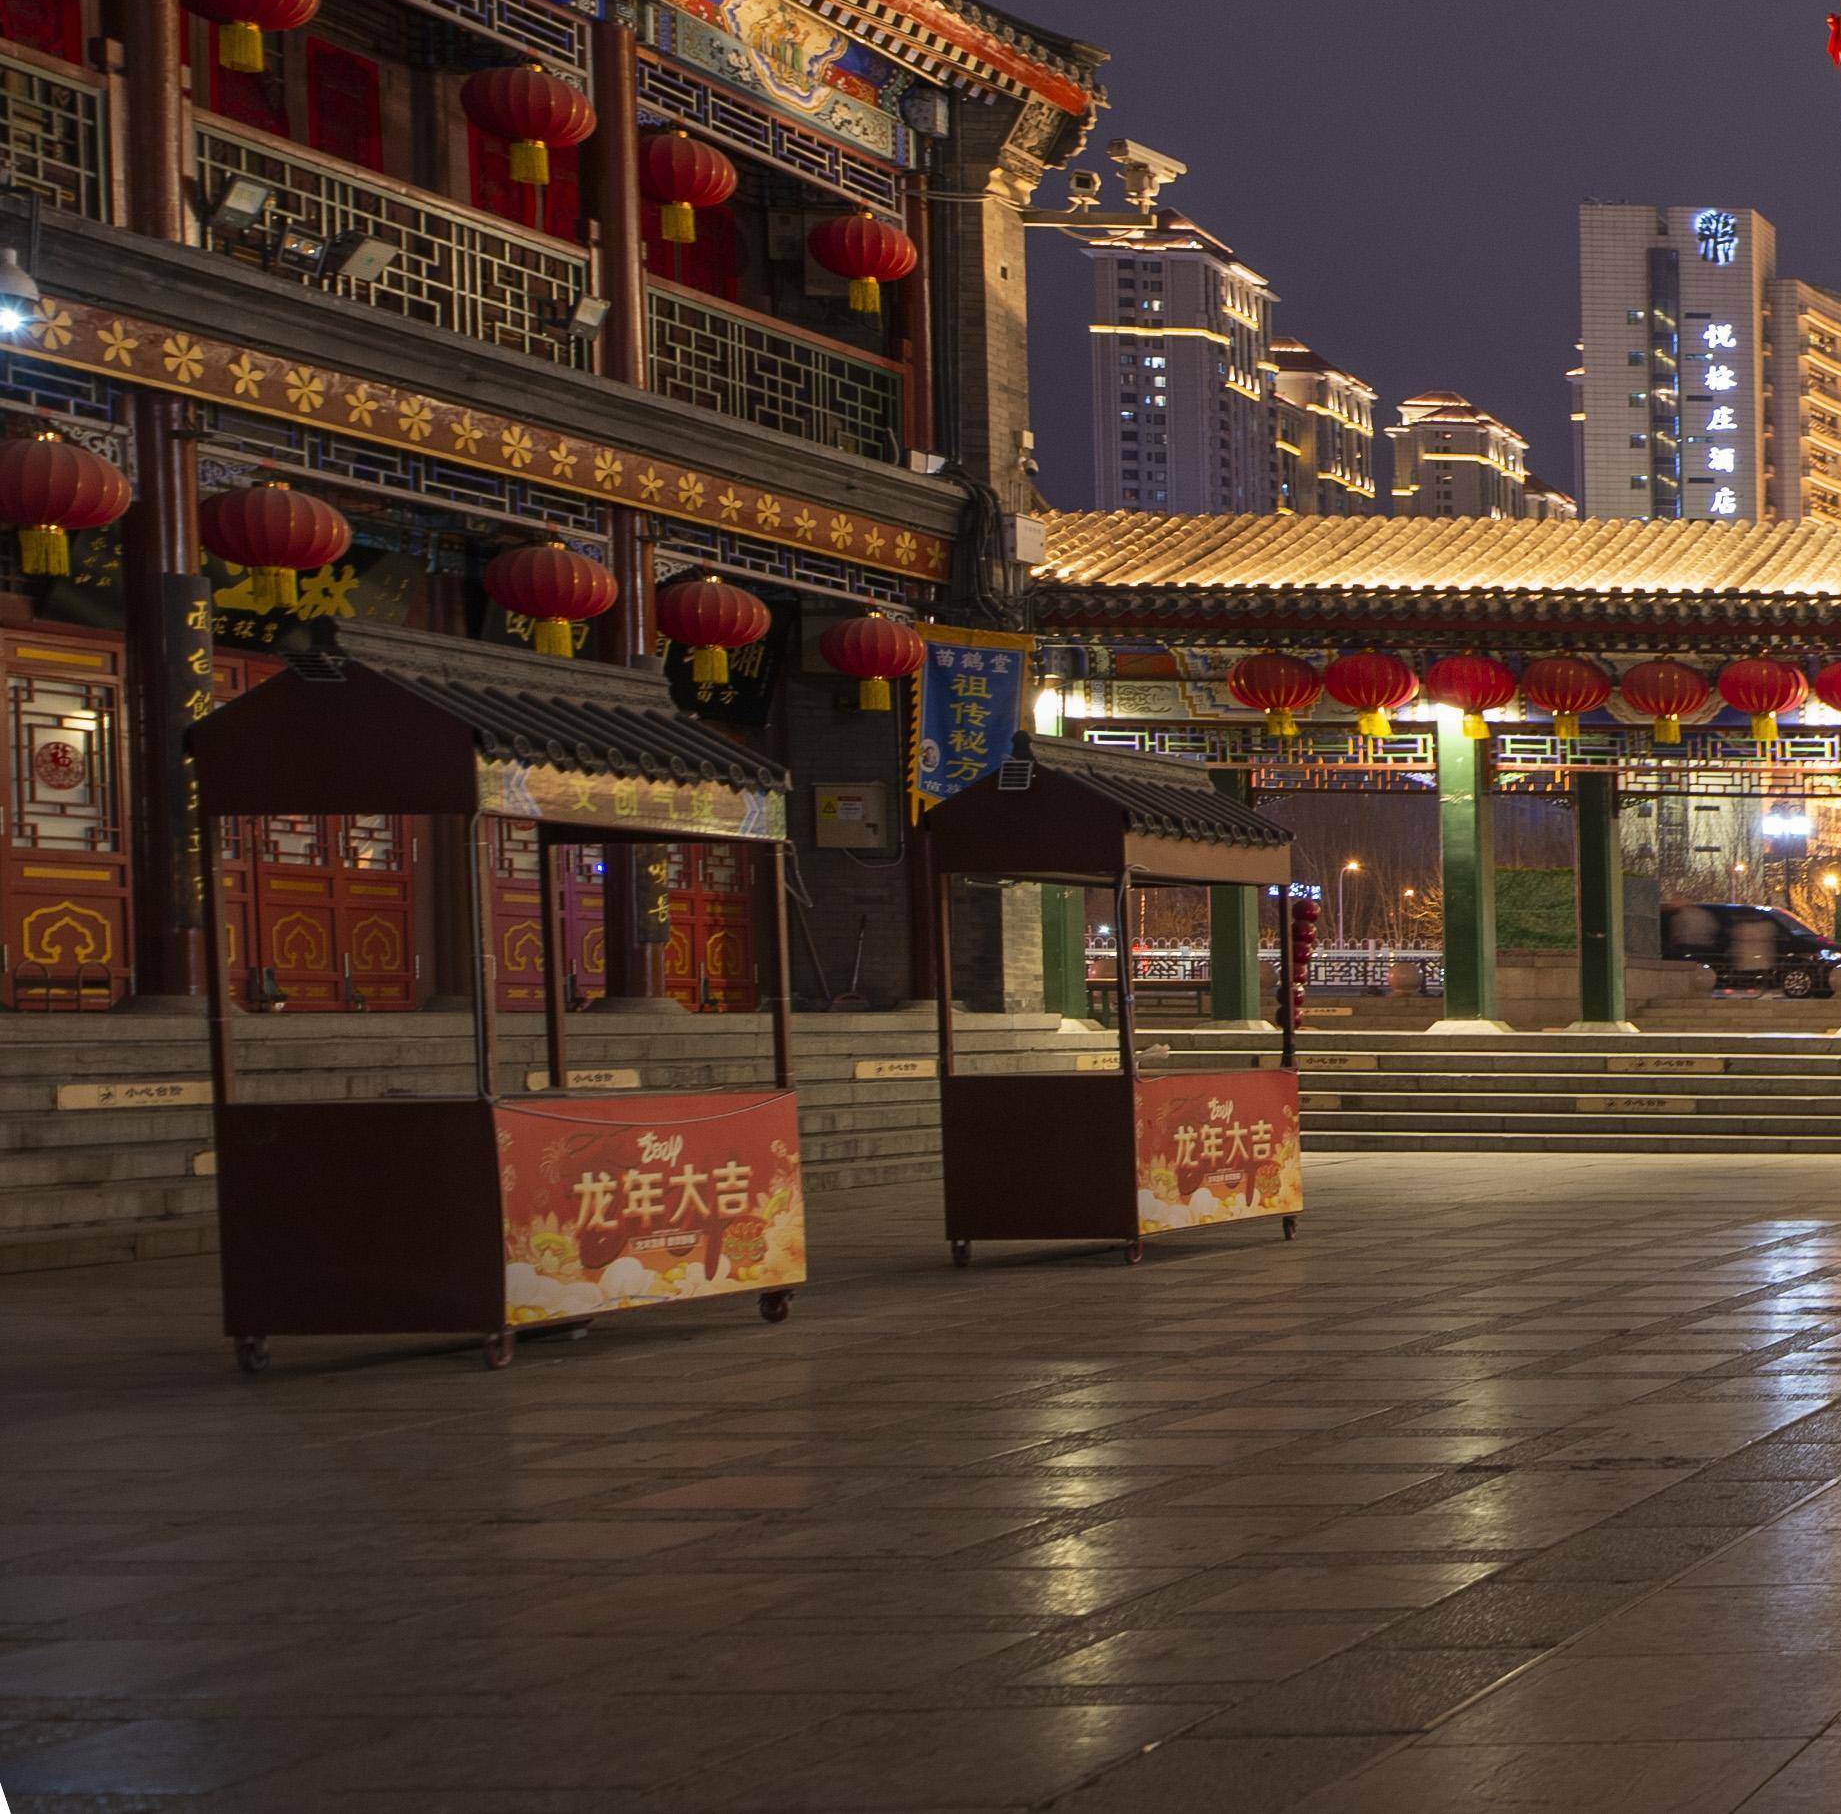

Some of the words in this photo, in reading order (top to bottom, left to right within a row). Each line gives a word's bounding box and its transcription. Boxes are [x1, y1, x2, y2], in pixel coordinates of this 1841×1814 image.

[1702, 323, 1738, 516] 悦榕庄酒店
[946, 673, 993, 782] 祖传秘方
[1173, 1119, 1274, 1168] 龙年大吉
[572, 1161, 753, 1231] 龙年大吉
